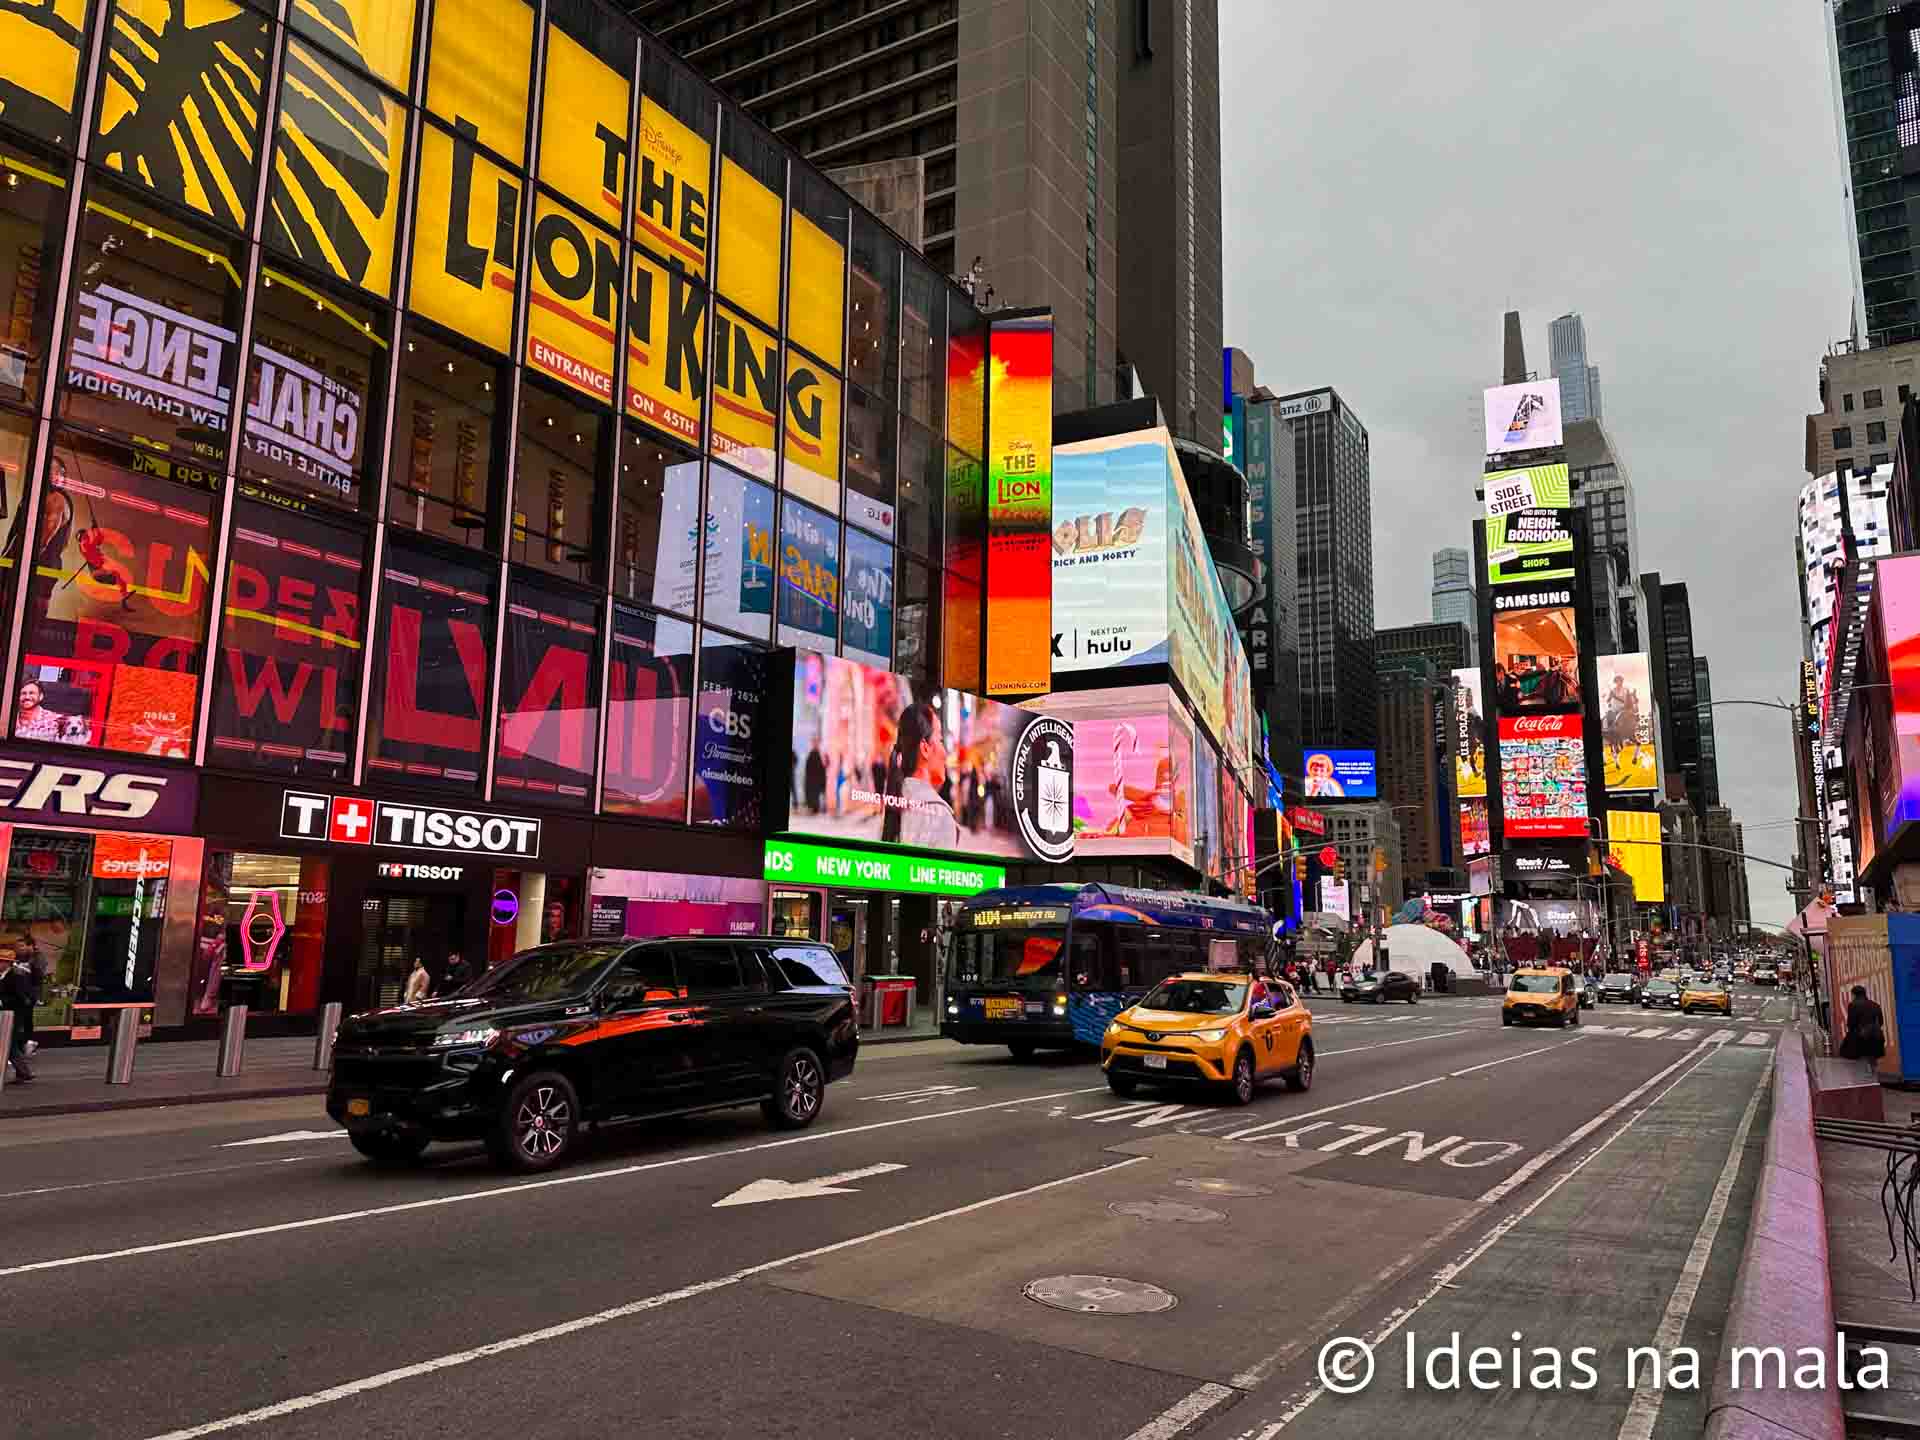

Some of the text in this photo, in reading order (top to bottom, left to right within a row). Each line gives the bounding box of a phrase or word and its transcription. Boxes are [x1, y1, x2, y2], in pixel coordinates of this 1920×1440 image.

[594, 122, 706, 251] THE
[445, 114, 823, 440] LION KING
[533, 342, 744, 457] ENTRANCE ON 45TH STREE
[1003, 453, 1036, 470] THE
[998, 479, 1040, 505] LION
[1495, 484, 1523, 501] SIDE
[1490, 494, 1533, 514] STREET
[1518, 516, 1561, 530] NEIGH-
[1508, 529, 1569, 542] BORHOOD
[1053, 557, 1076, 568] RICK
[1079, 553, 1100, 565] AND
[1522, 558, 1550, 568] SHOPS
[1251, 538, 1268, 669] SUARE
[1495, 590, 1571, 609] SAMSUNG
[1112, 626, 1128, 635] DAY
[1087, 637, 1132, 655] hulu
[709, 707, 752, 739] CBS
[1016, 743, 1031, 801] CENTRAL
[851, 789, 881, 804] BRING
[883, 794, 908, 809] YOUR
[381, 807, 537, 853] TISSOT
[403, 863, 463, 880] TISSOT
[816, 855, 852, 878] NEW
[855, 861, 891, 880] YORK
[910, 865, 936, 884] LINE
[938, 870, 984, 889] FRIENDS
